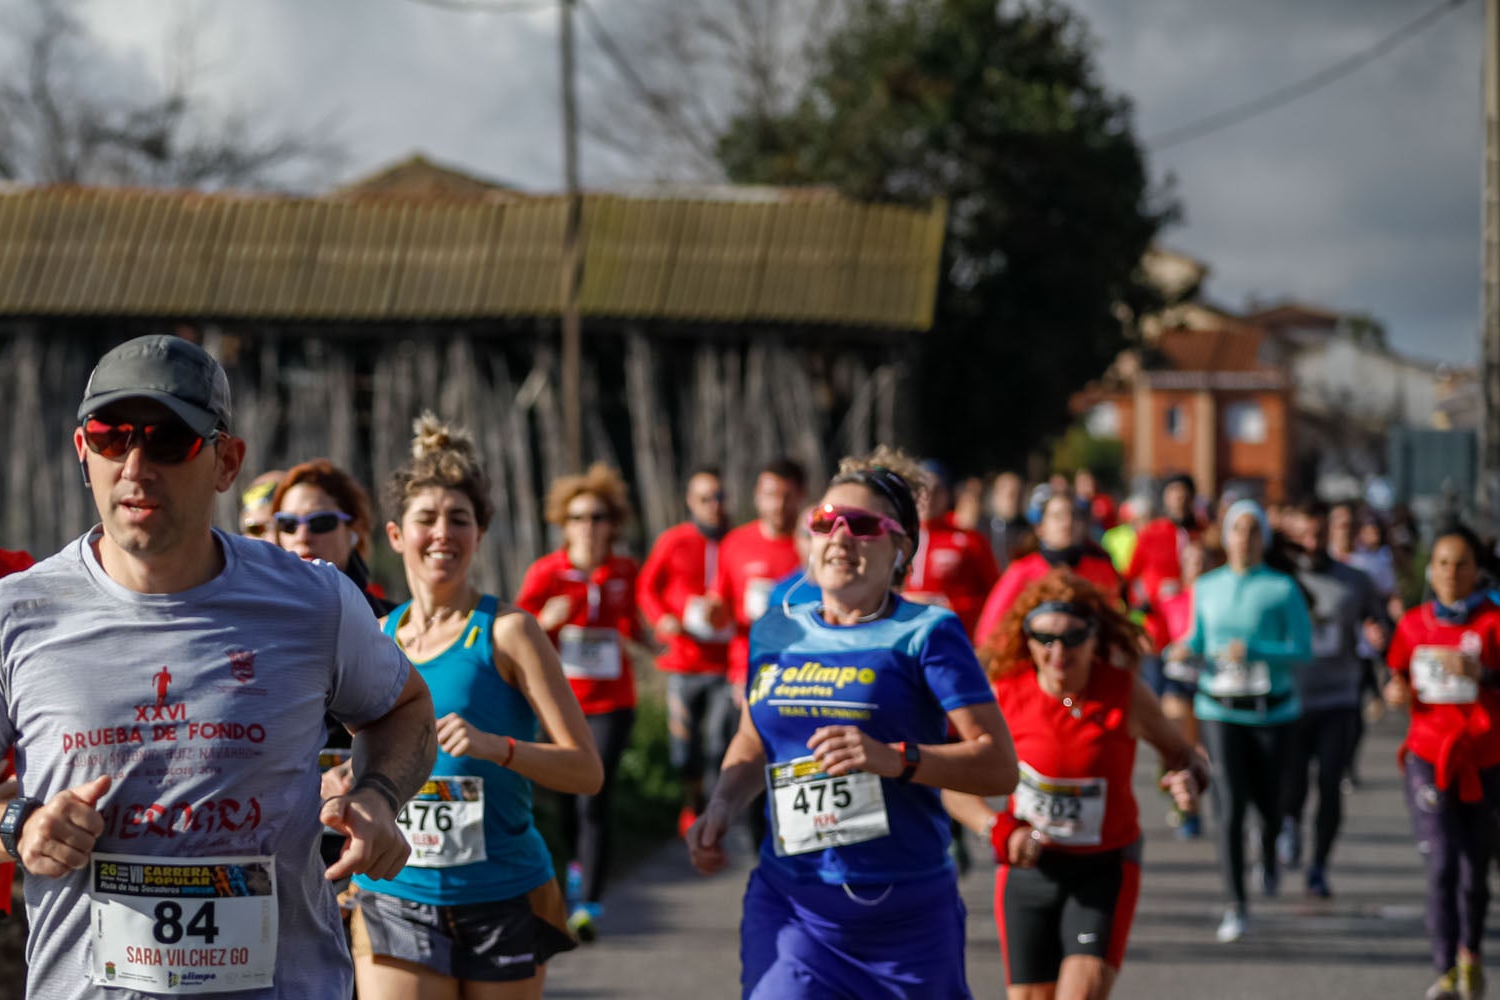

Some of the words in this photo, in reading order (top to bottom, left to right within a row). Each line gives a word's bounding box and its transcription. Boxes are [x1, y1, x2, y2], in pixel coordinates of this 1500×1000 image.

[781, 661, 876, 689] olimpo
[774, 683, 833, 699] deportes
[135, 703, 187, 722] XXVI
[779, 705, 808, 717] TRAIL
[820, 707, 871, 720] RUNNING
[63, 725, 143, 753] PRUEBA
[152, 723, 177, 741] DE
[188, 722, 266, 743] FONDO
[793, 780, 852, 815] 475
[397, 804, 452, 832] 476
[100, 863, 117, 876] 26
[144, 866, 211, 877] CARRERA
[100, 881, 117, 891] Ruta
[118, 882, 127, 892] de
[140, 884, 181, 894] Secaderos
[144, 875, 210, 886] POPULAR
[153, 900, 219, 944] 84
[126, 945, 162, 966] SARA
[166, 948, 226, 967] VILCHEZ
[230, 947, 249, 965] GO
[181, 972, 216, 982] olimpo
